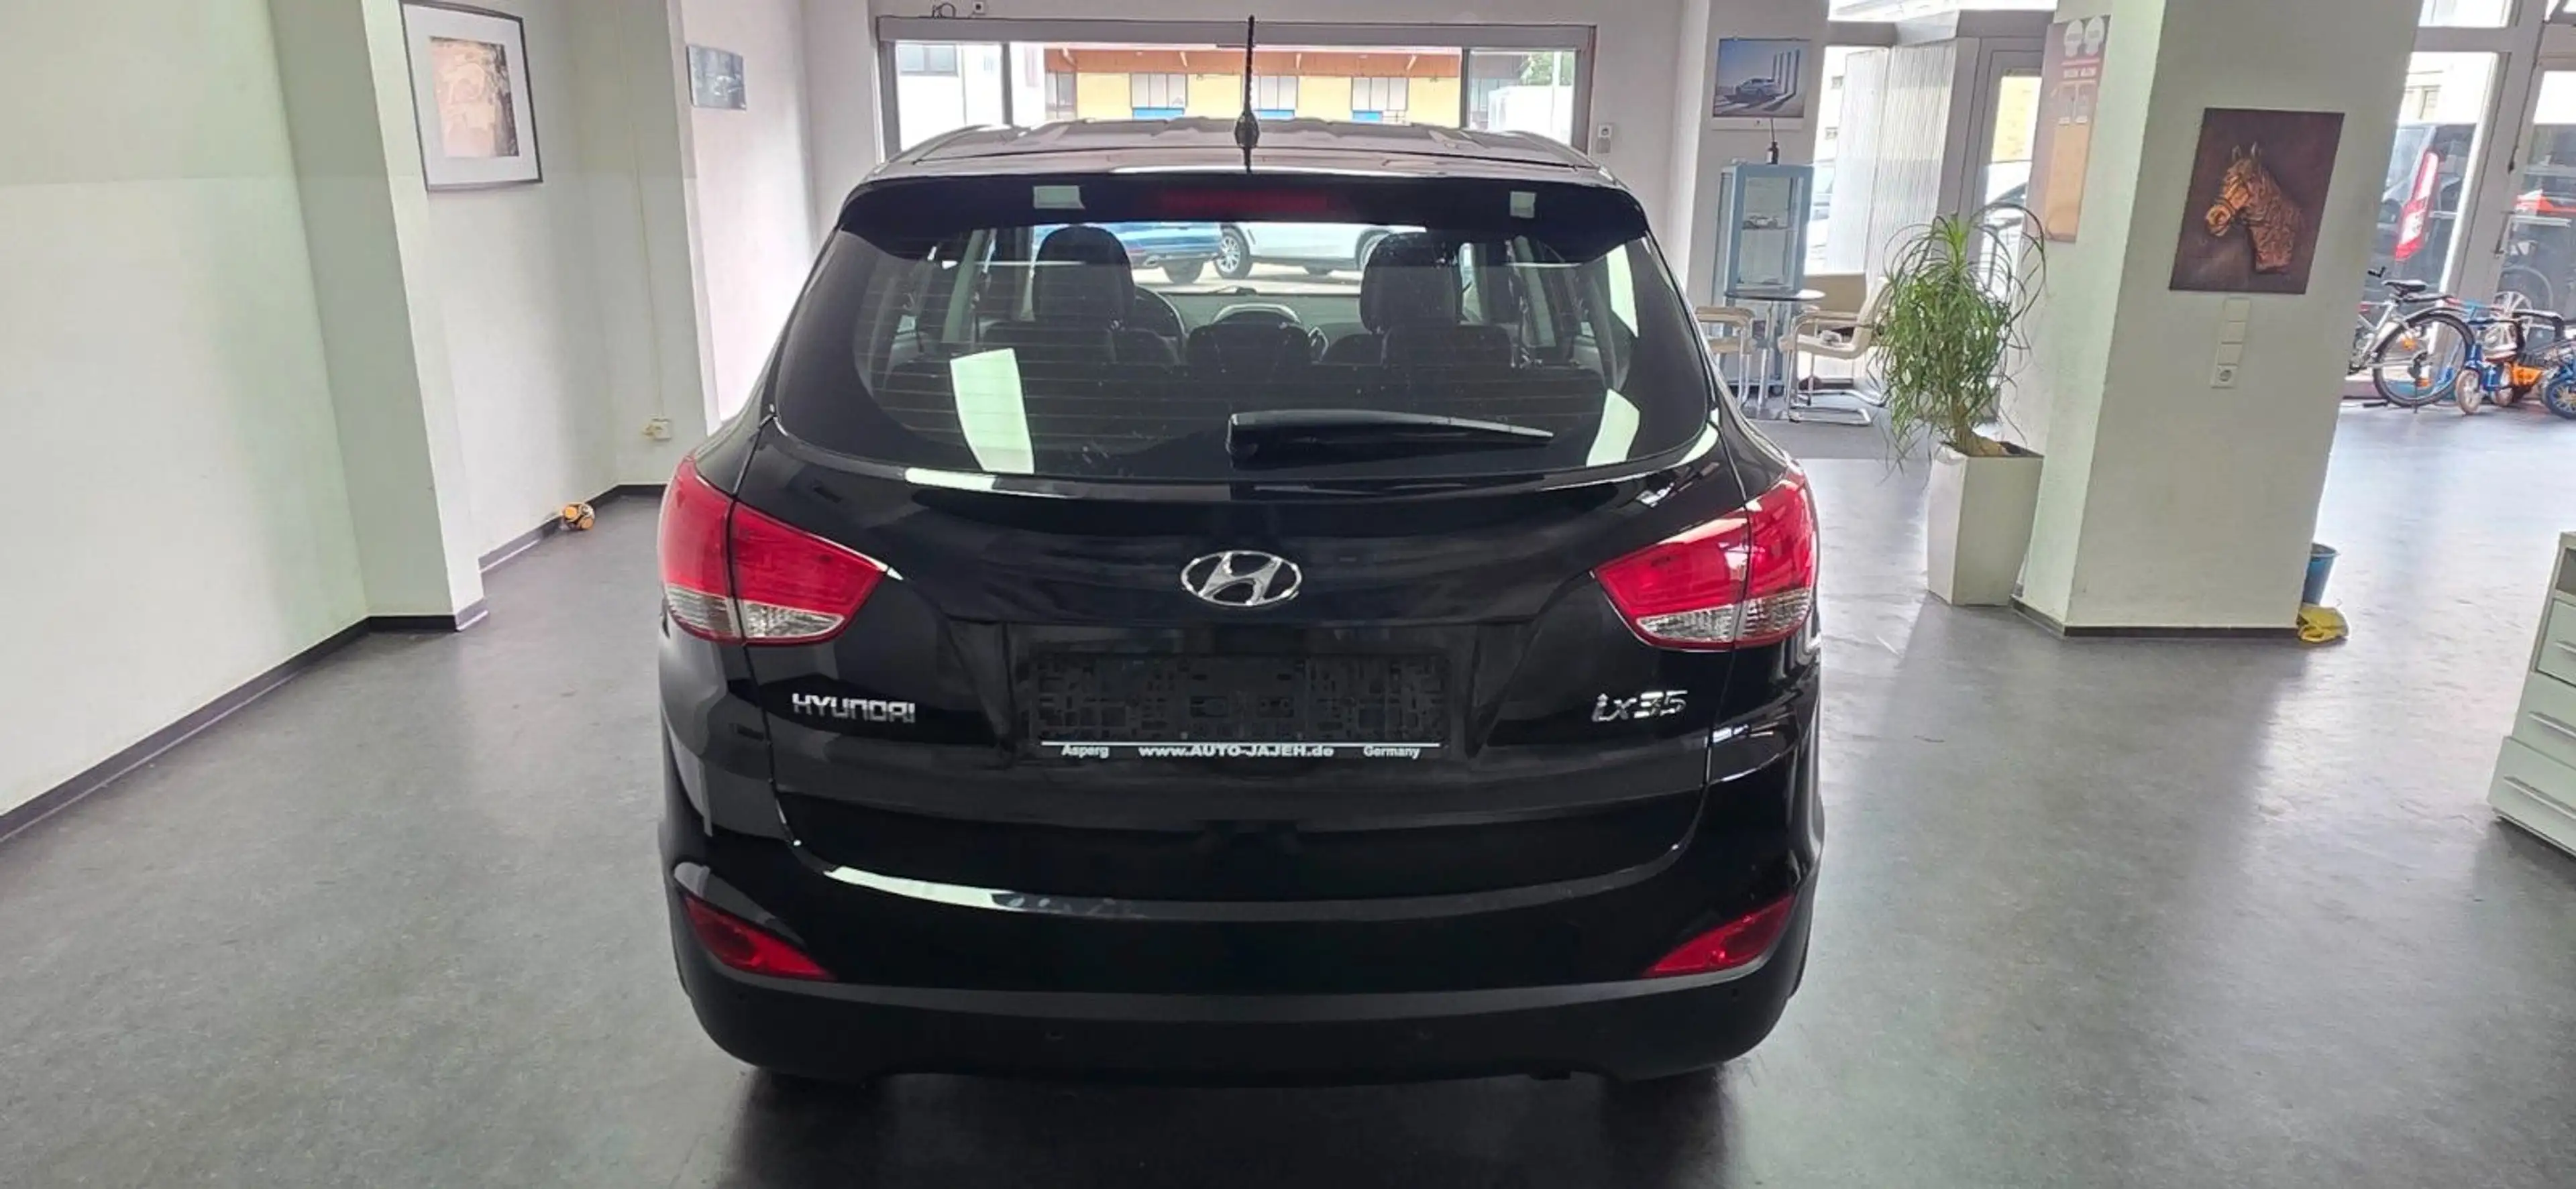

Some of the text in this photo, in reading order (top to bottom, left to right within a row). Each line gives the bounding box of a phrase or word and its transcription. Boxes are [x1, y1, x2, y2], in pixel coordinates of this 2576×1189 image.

[792, 693, 915, 723] HYUNDAI
[1592, 690, 1688, 722] ix35
[1061, 744, 1420, 759] Asperg www.AUTO-JAJEH.de Germany
